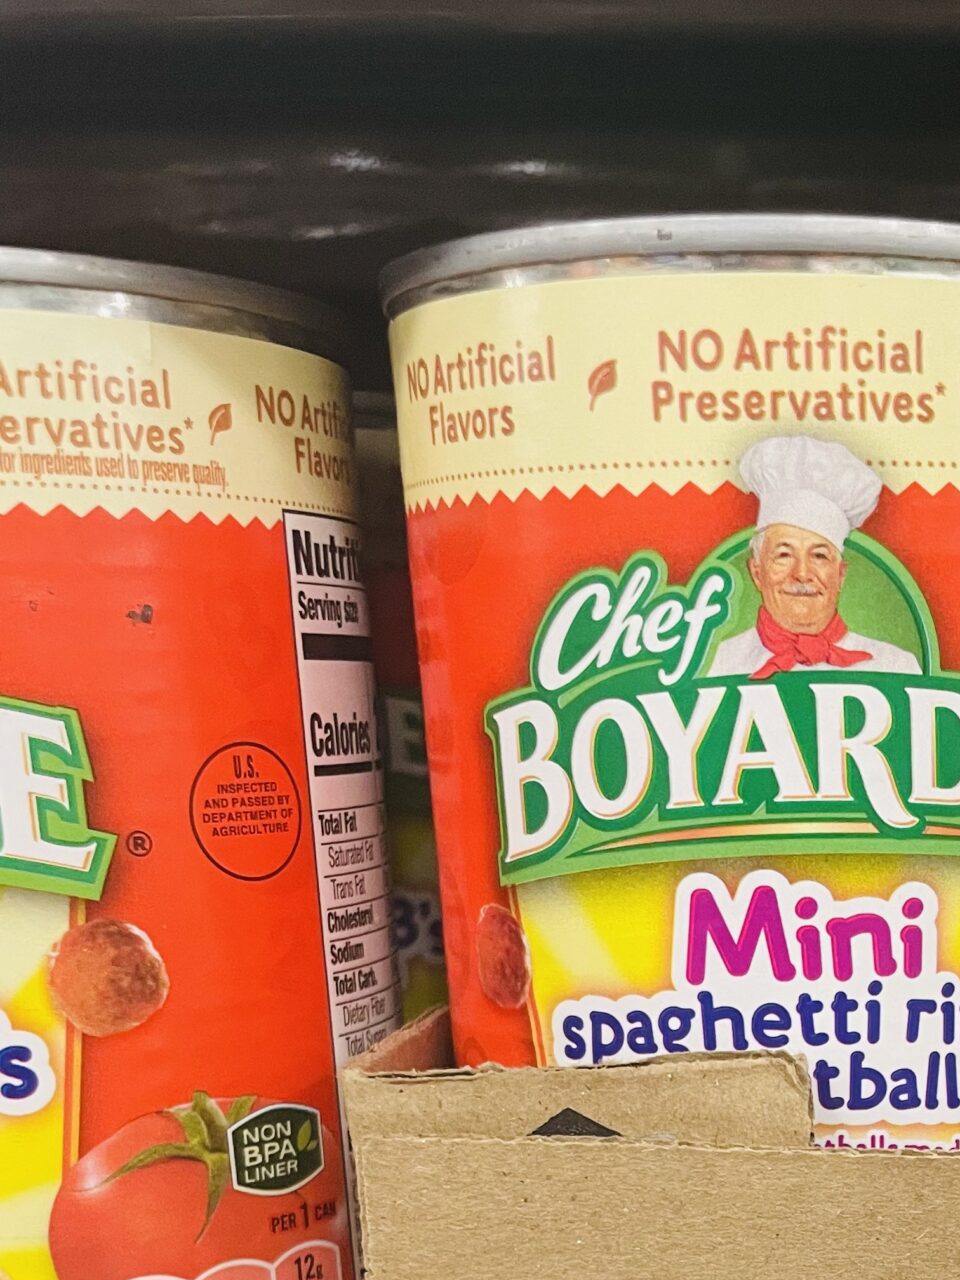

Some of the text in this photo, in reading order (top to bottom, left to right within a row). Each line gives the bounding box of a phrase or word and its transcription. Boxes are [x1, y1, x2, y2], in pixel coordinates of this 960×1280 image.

[657, 326, 923, 374] NO Artificial
[407, 335, 555, 403] NO Artificial
[255, 384, 343, 439] NO Artif
[429, 402, 515, 445] Flavors
[0, 411, 194, 455] ervatives
[20, 448, 92, 479] ingredients
[95, 452, 124, 478] used
[127, 457, 139, 479] to
[142, 460, 190, 488] preserve
[292, 529, 361, 581] Nutrit
[298, 590, 342, 628] Serving
[537, 566, 724, 691] Chef
[309, 712, 371, 757] Calories
[233, 755, 259, 779] U.S.
[204, 794, 291, 809] AND PASSED BY
[217, 781, 277, 795] INSPECTED
[202, 808, 294, 823] DEPARTMENT OF
[211, 821, 289, 838] AGRICULTURE
[318, 810, 357, 837] Total Fat
[330, 878, 353, 901] Trans
[327, 904, 373, 933] Cholesterol
[686, 884, 923, 985] Mini
[330, 940, 365, 965] Sodium
[334, 971, 357, 997] Total
[563, 980, 880, 1062] spaghetti
[243, 1121, 291, 1145] NON
[243, 1142, 297, 1166] BPA
[245, 1160, 298, 1183] LINER
[271, 1202, 337, 1232] PER 1 CAN
